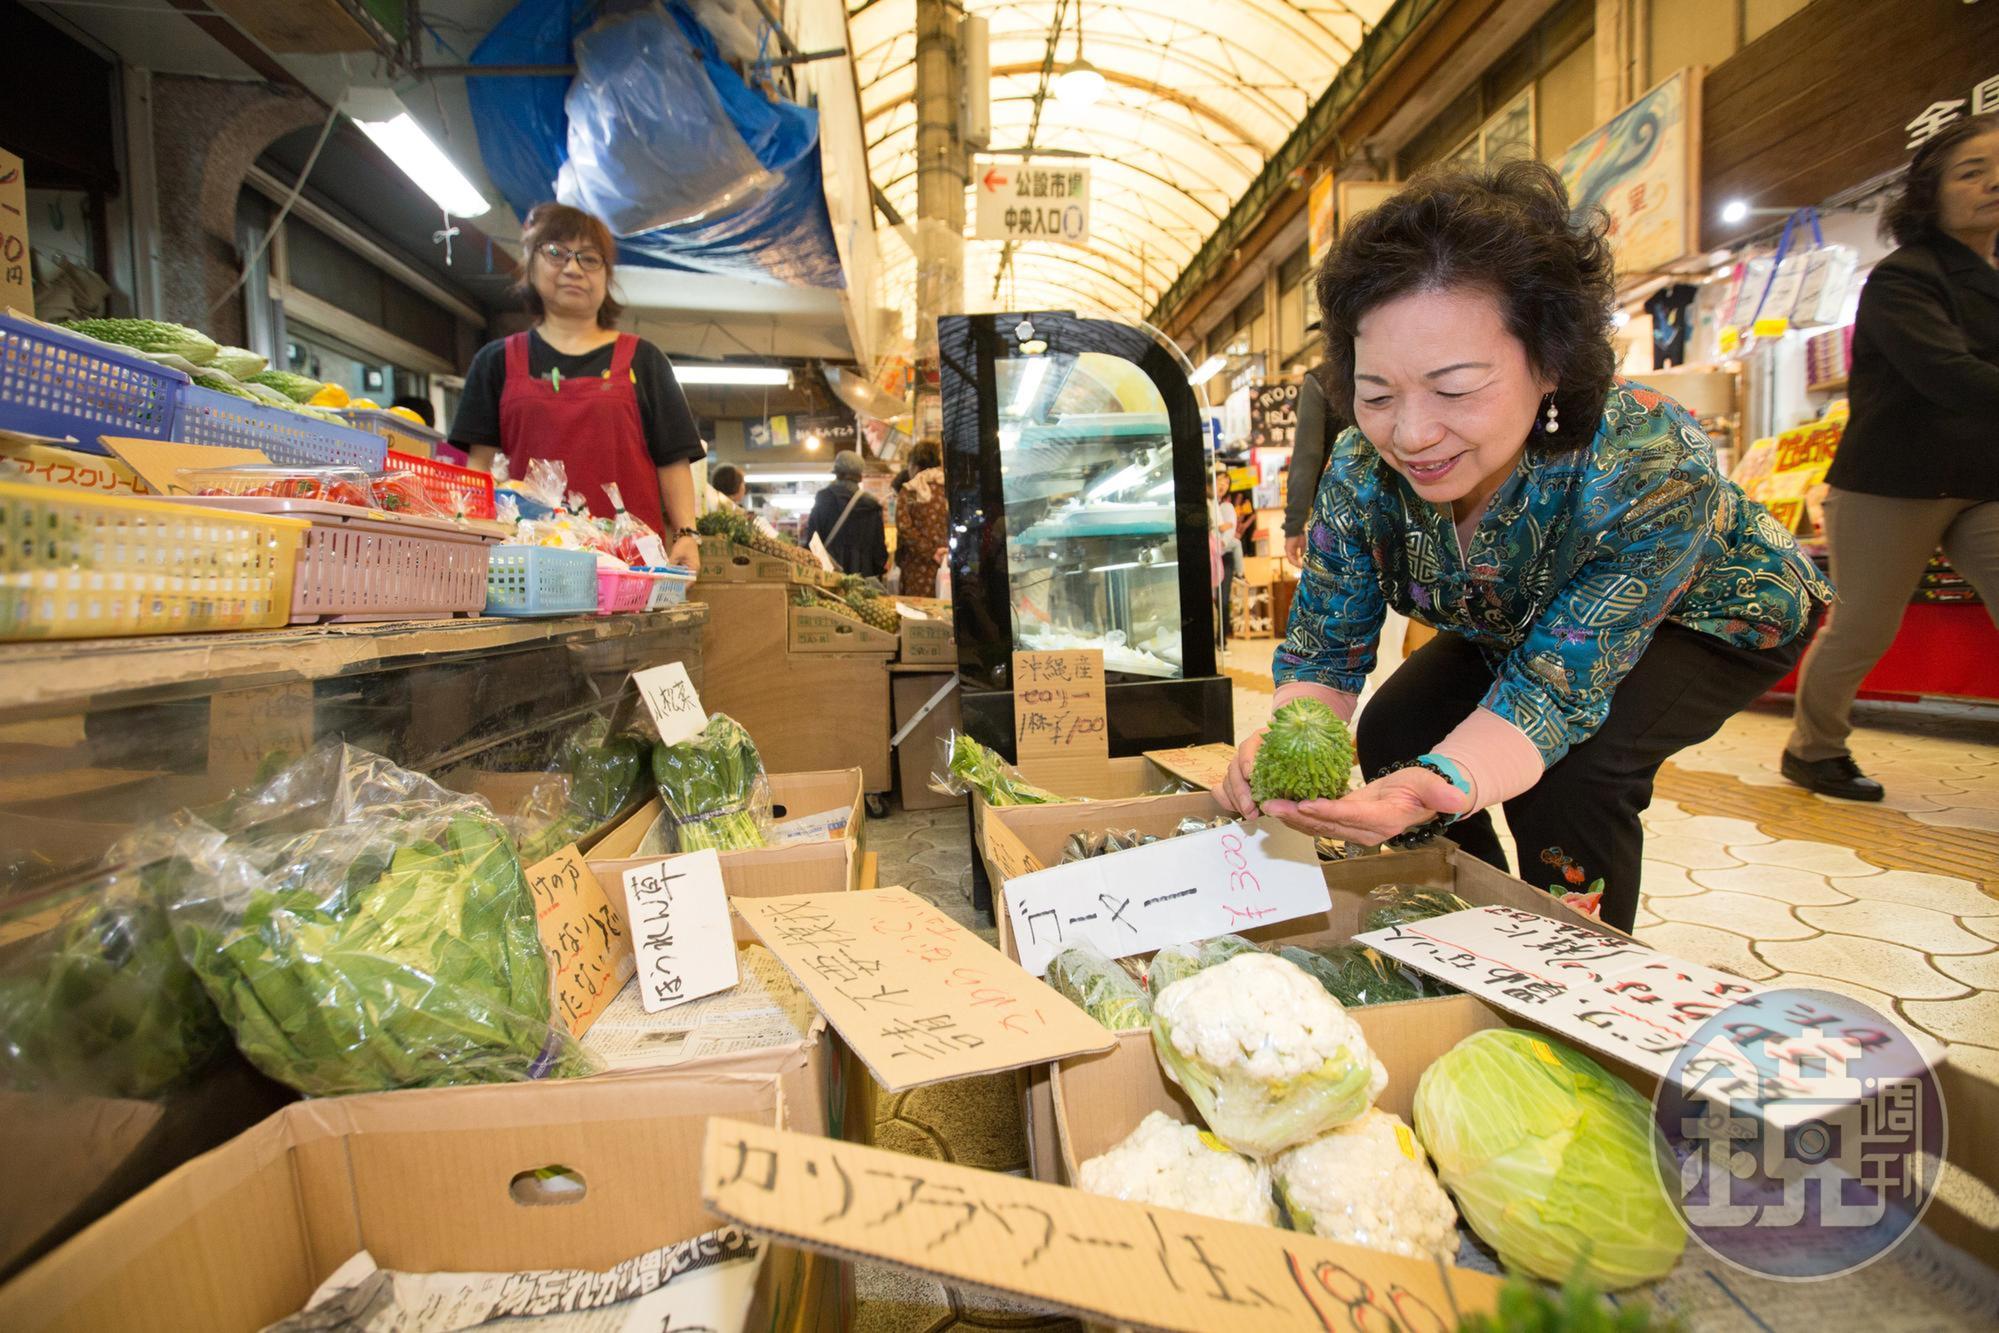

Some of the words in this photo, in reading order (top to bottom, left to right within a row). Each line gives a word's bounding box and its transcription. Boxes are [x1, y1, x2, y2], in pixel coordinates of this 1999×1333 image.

[1016, 171, 1082, 197] 公設市場
[1004, 205, 1060, 234] 中央入口
[1018, 654, 1093, 682] 沖縄産
[646, 680, 697, 722] 小松菜
[631, 862, 687, 1002] ほうれん草
